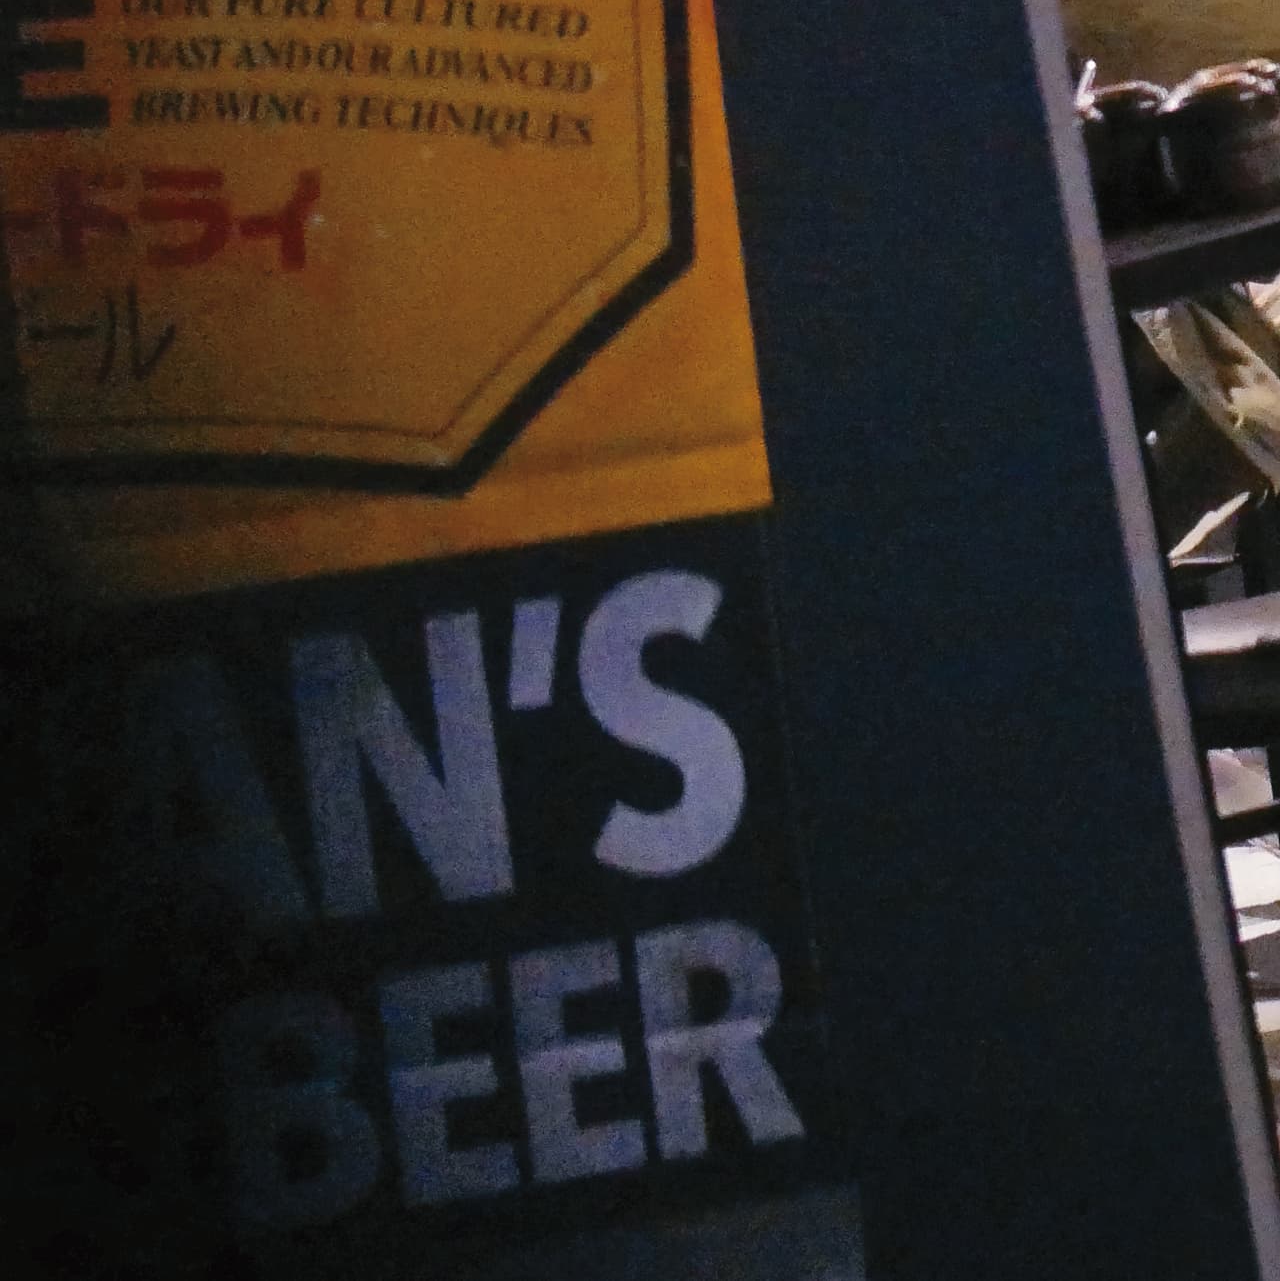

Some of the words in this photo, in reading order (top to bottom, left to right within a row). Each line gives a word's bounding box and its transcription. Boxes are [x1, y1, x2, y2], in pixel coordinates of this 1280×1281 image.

[402, 45, 594, 94] ADVANCED
[132, 89, 320, 128] BREWING
[335, 94, 594, 147] TECHNIQUES
[218, 919, 804, 1231] BEER
